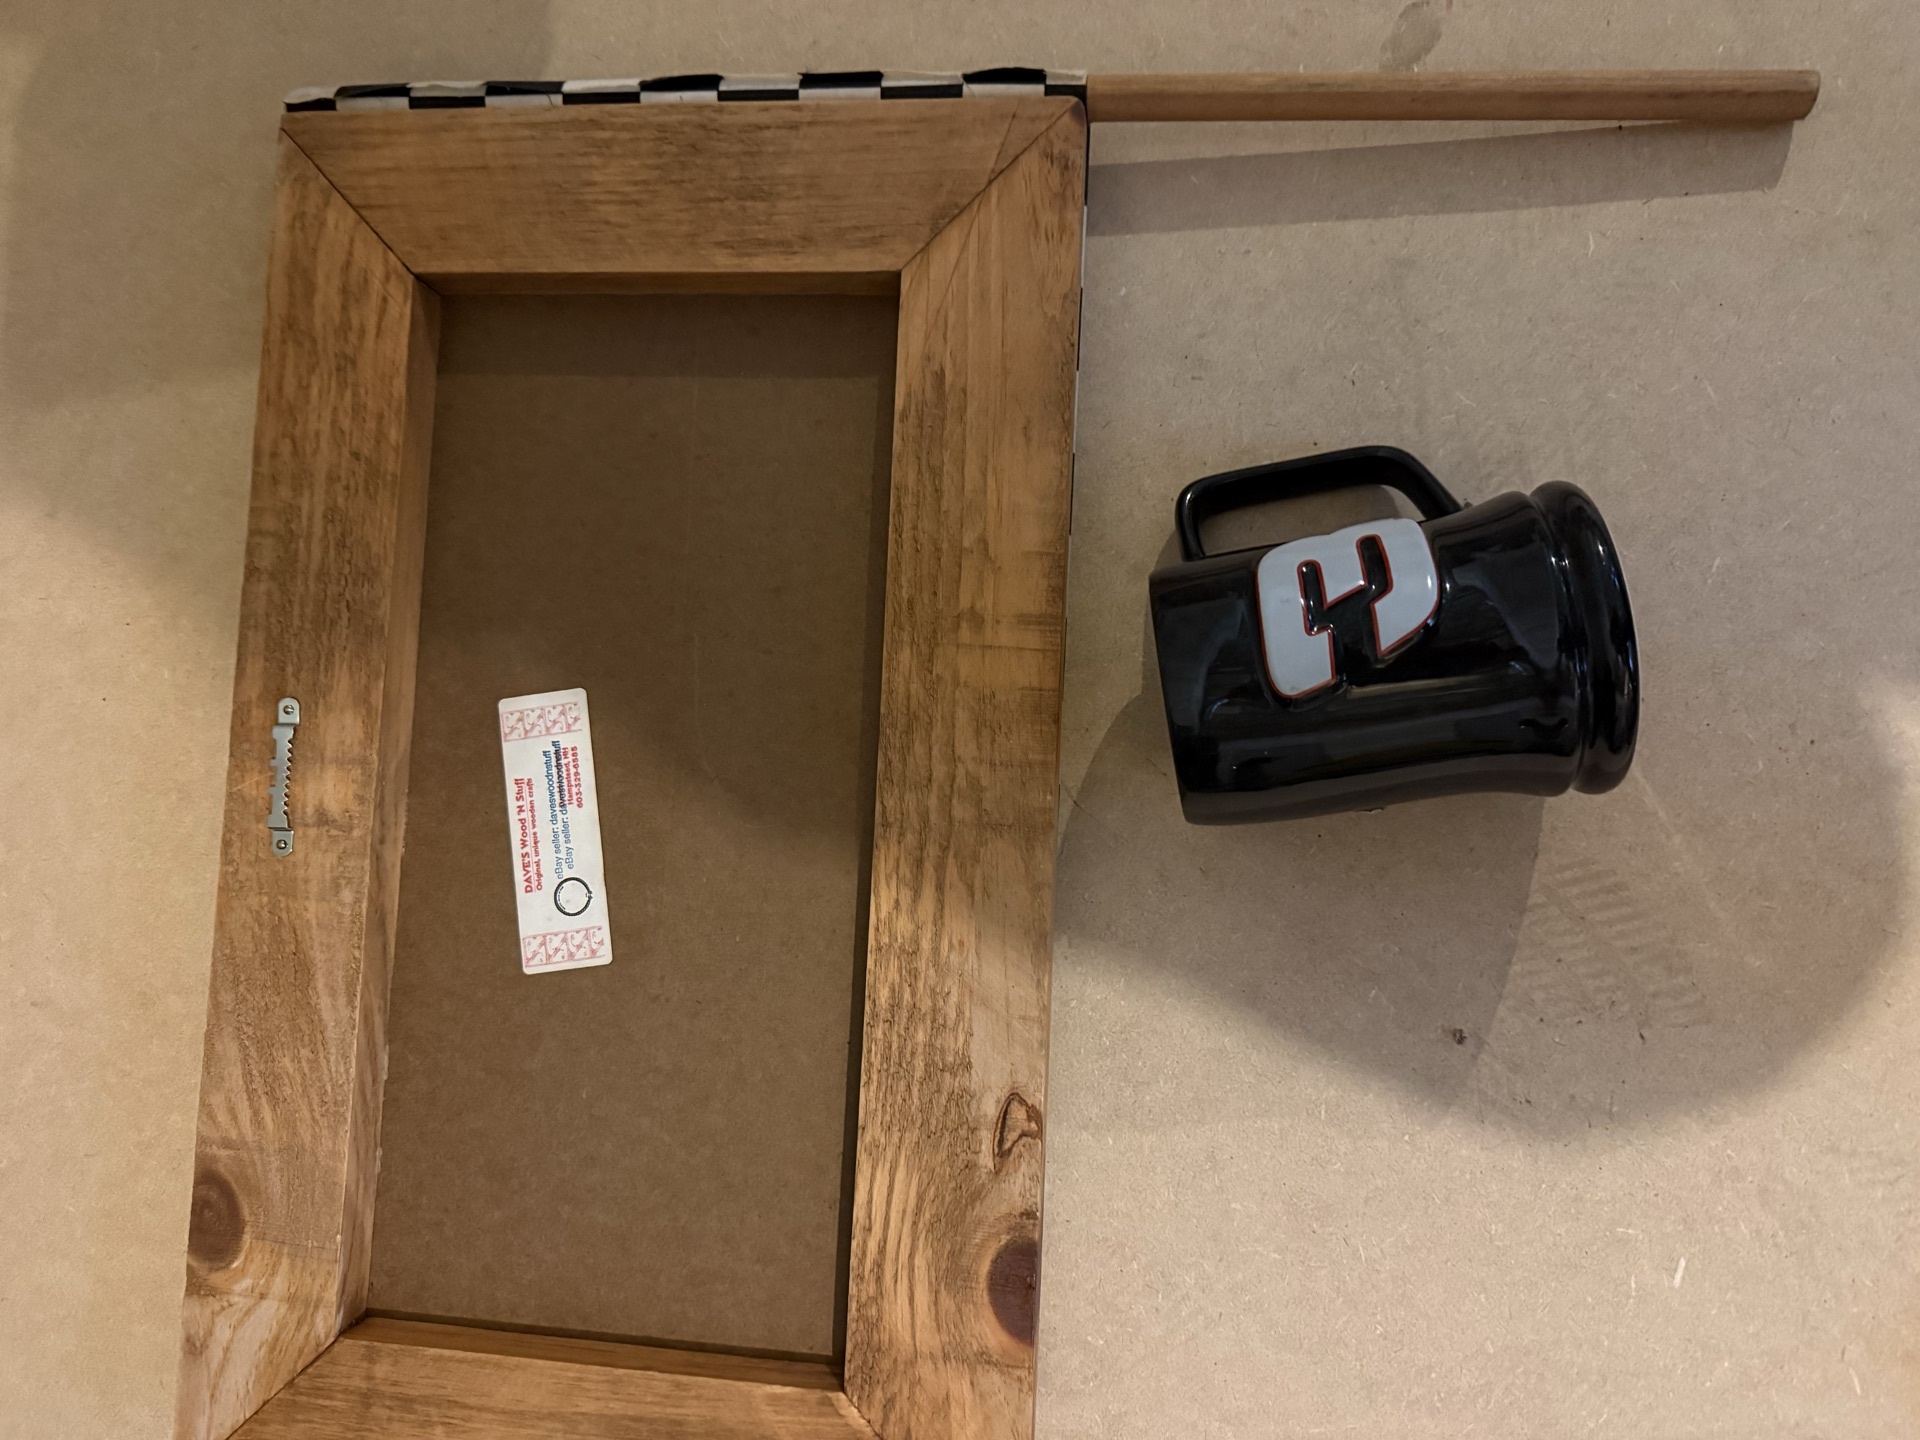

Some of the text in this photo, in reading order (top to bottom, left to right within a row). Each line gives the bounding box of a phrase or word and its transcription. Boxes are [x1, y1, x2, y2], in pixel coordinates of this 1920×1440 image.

[1255, 517, 1439, 699] 3
[514, 778, 525, 802] Stuff
[542, 750, 558, 825] daveswoodnstuff
[563, 761, 574, 805] Hampstead,
[518, 818, 528, 849] Wood
[526, 778, 543, 891] Original, unique wooden crafts
[551, 827, 561, 854] seller:
[561, 817, 571, 844] seller:
[521, 851, 533, 894] DAVE'S
[554, 856, 564, 879] eBay
[565, 846, 574, 870] eBay
